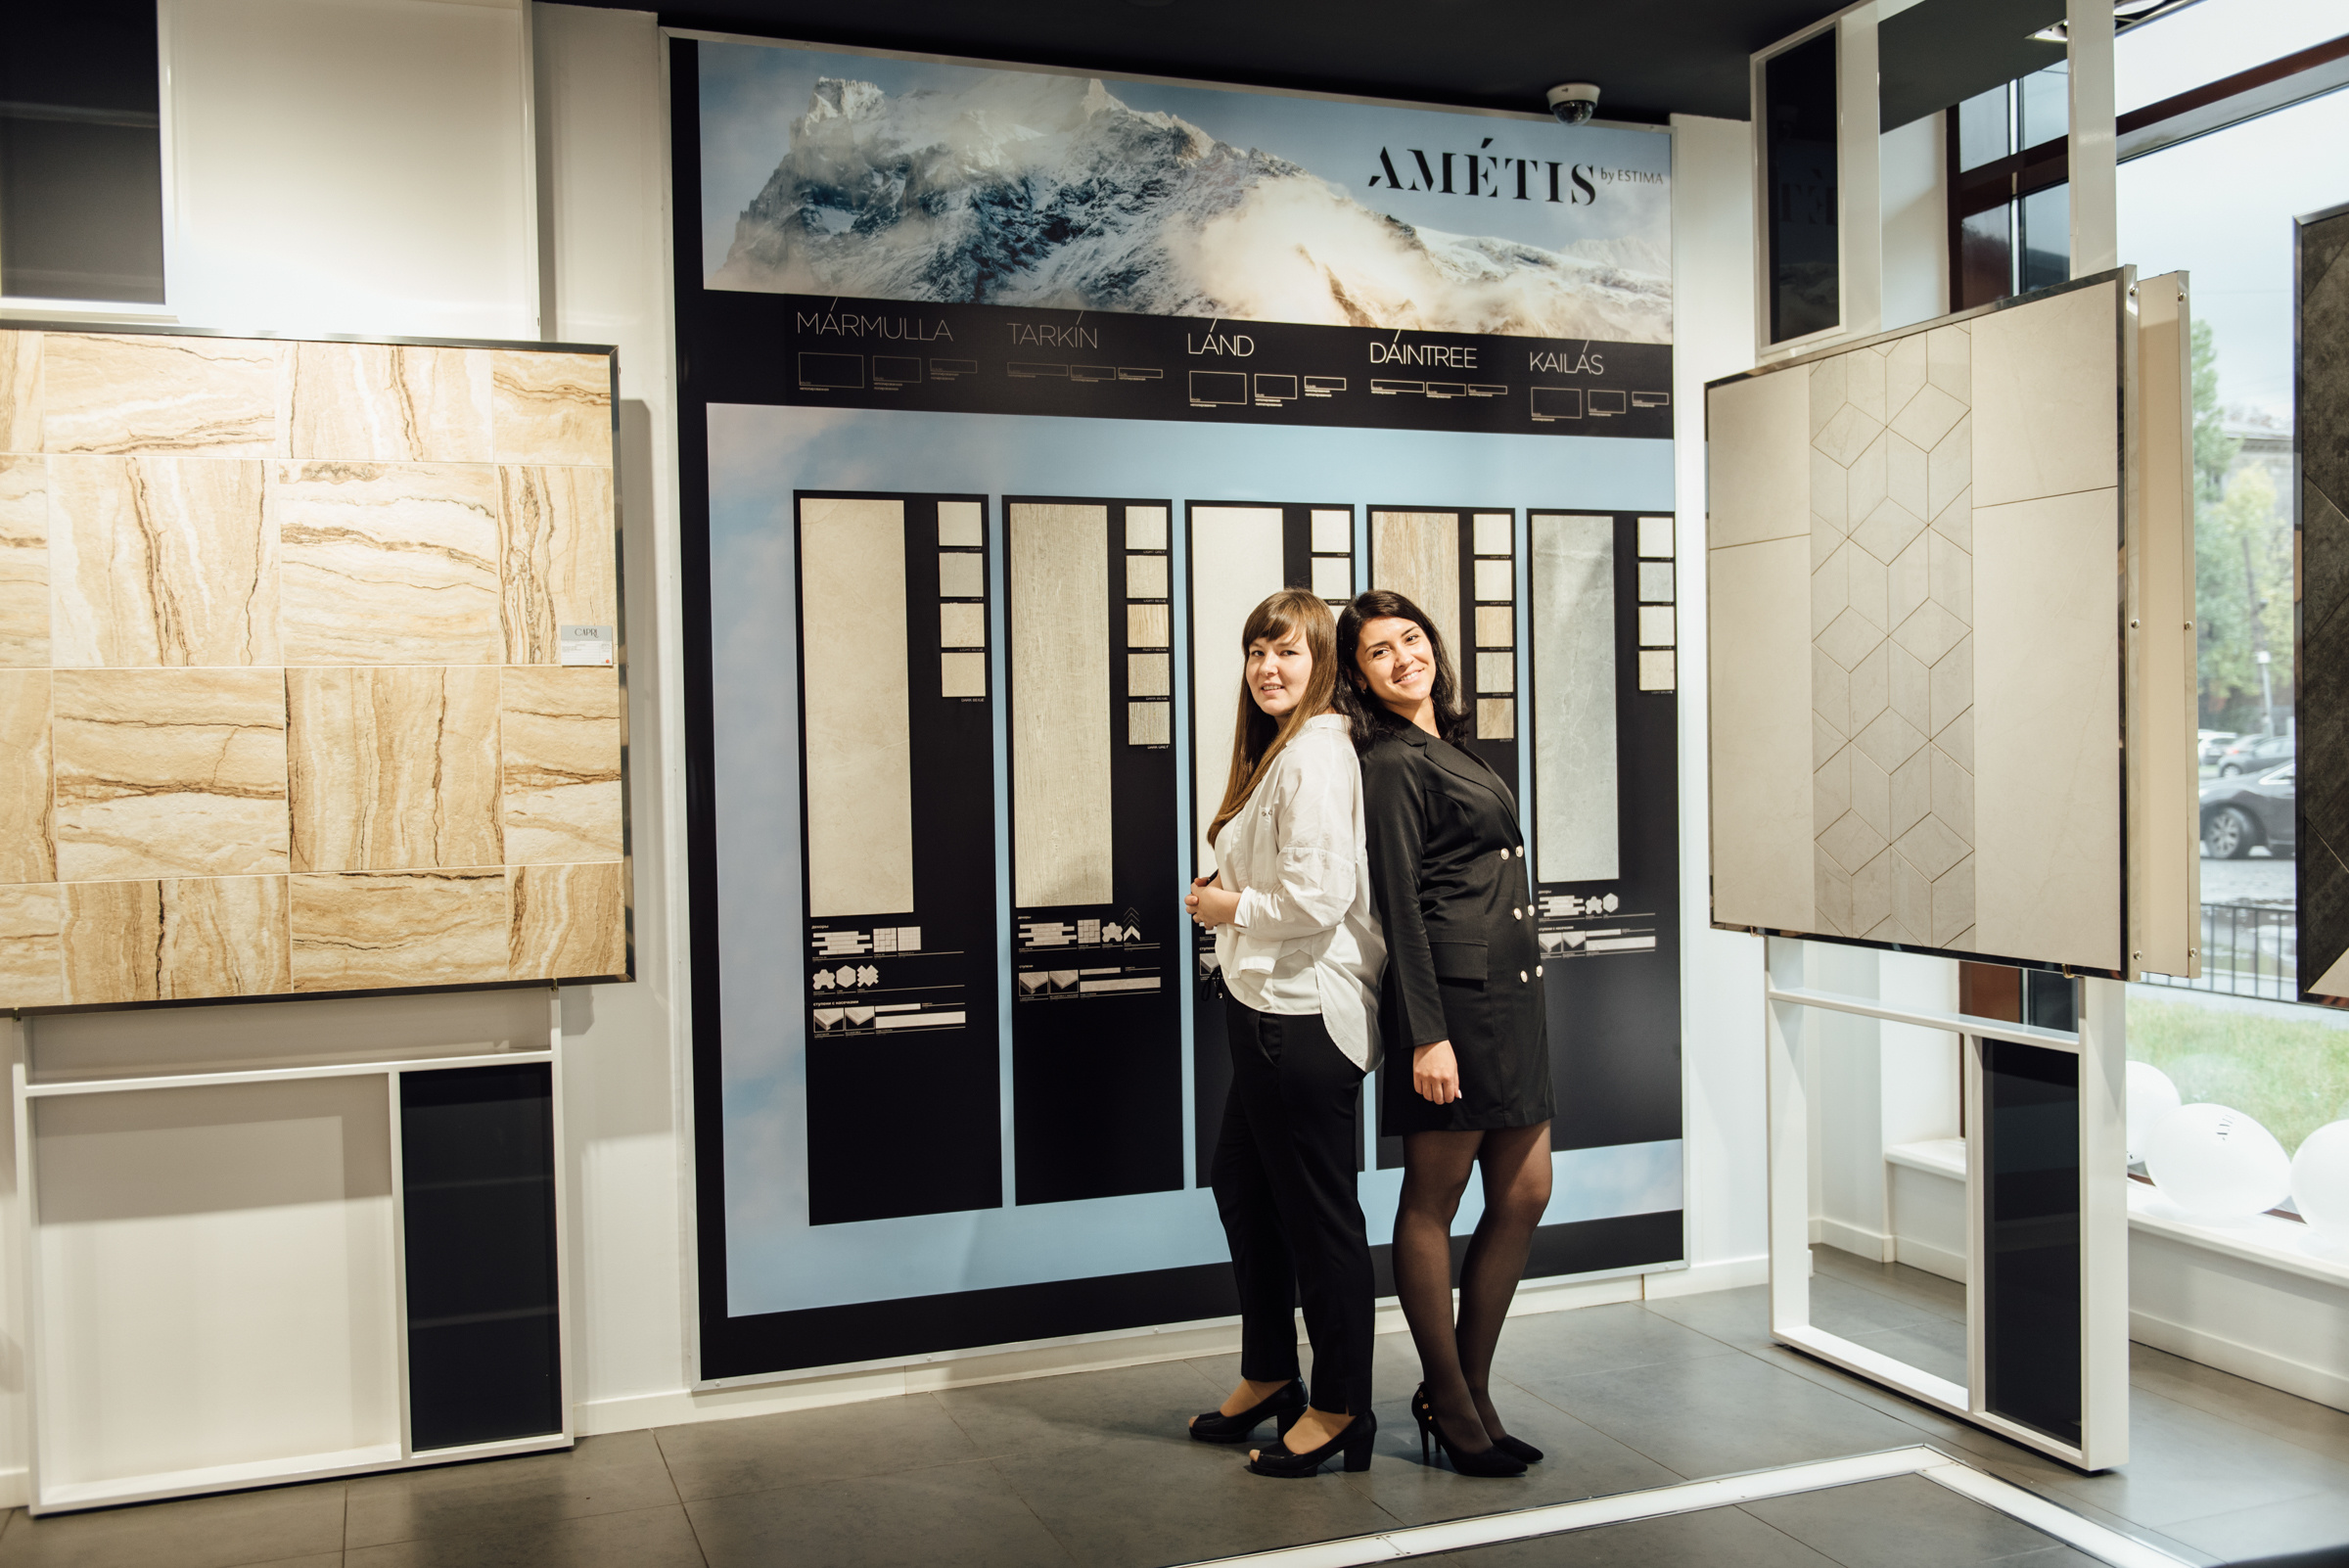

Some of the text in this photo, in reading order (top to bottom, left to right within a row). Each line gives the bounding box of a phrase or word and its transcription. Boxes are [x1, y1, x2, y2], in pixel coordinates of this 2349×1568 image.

[1367, 137, 1664, 207] AMÉTIS by ESTIMA
[797, 297, 953, 343] MÁRMULLA
[1006, 310, 1098, 349] TARKÍN
[1188, 318, 1255, 357] LÁND
[1370, 329, 1478, 369] DÁINTREE
[1530, 340, 1604, 376] KAILÁS
[575, 628, 599, 638] CAPRI
